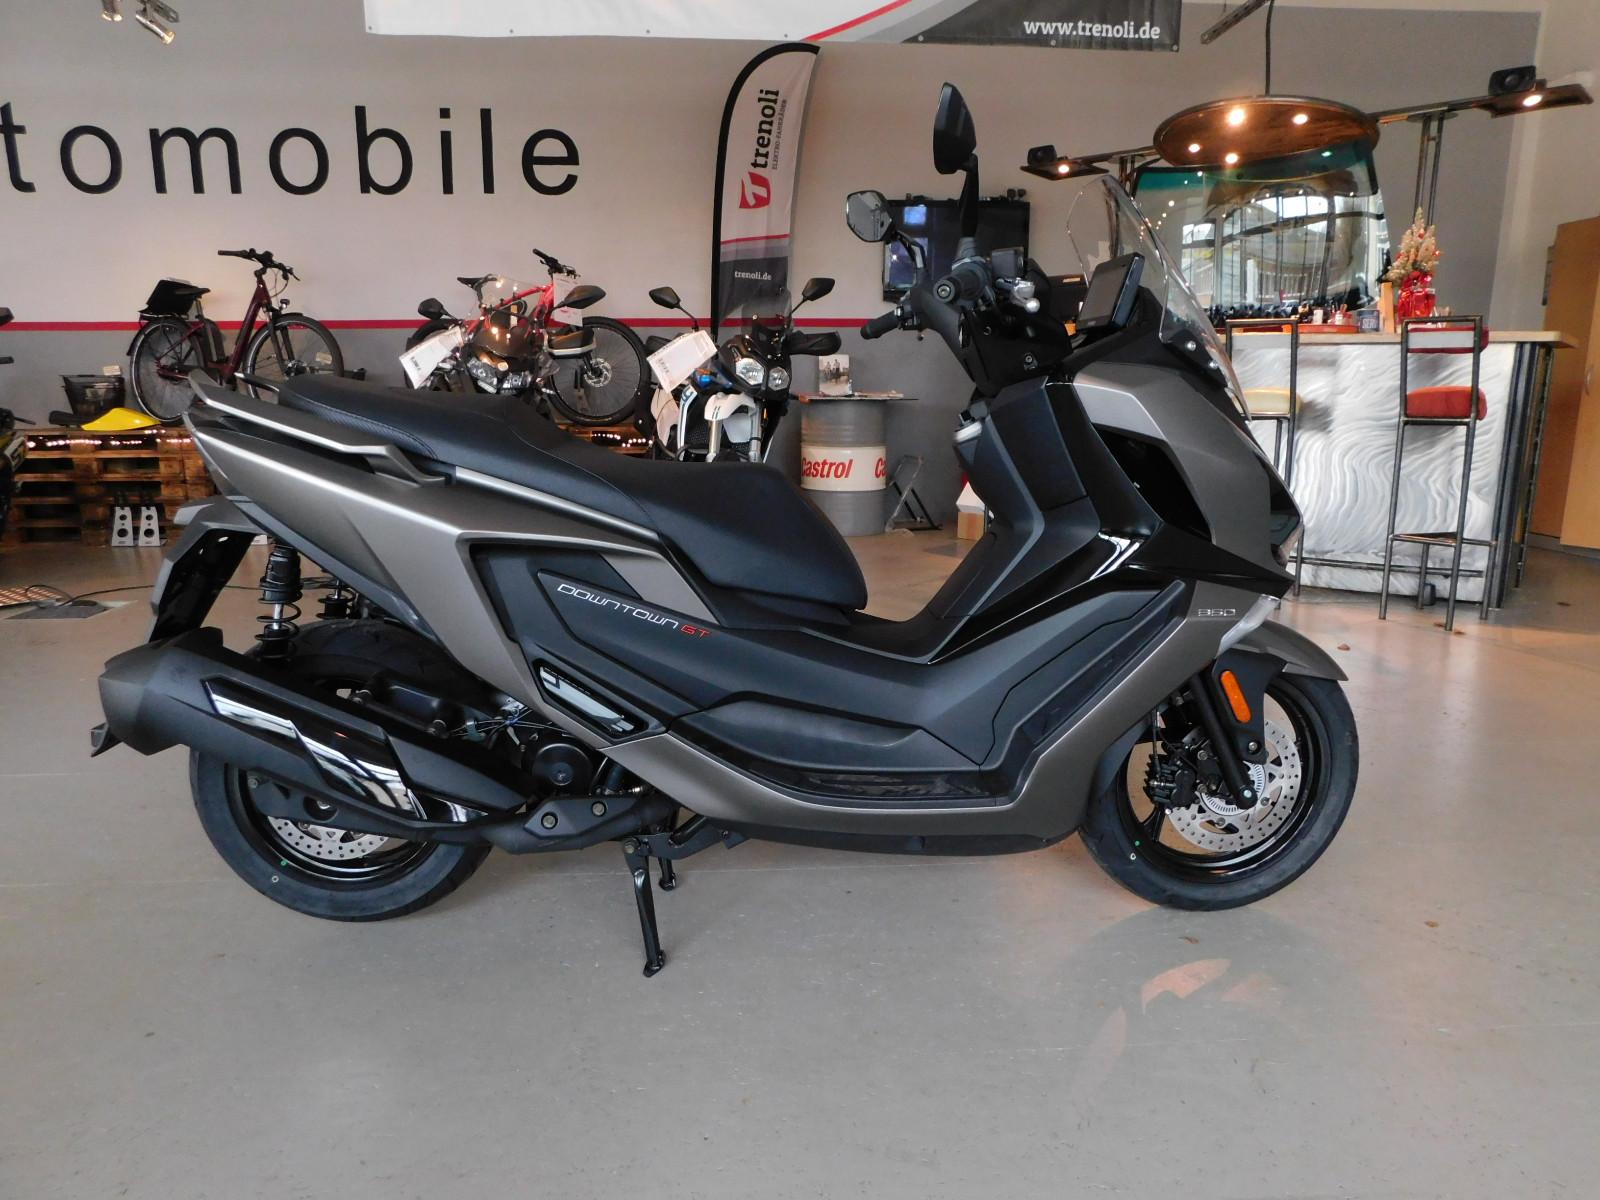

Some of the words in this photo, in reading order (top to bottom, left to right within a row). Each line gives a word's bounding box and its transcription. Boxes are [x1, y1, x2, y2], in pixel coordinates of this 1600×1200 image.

[1023, 20, 1161, 39] www.trenoli.de
[0, 100, 580, 195] tomobile
[750, 89, 779, 169] trenoli
[734, 271, 772, 280] trenoli.de
[557, 583, 680, 629] DOWNTOWN
[680, 624, 709, 639] GT
